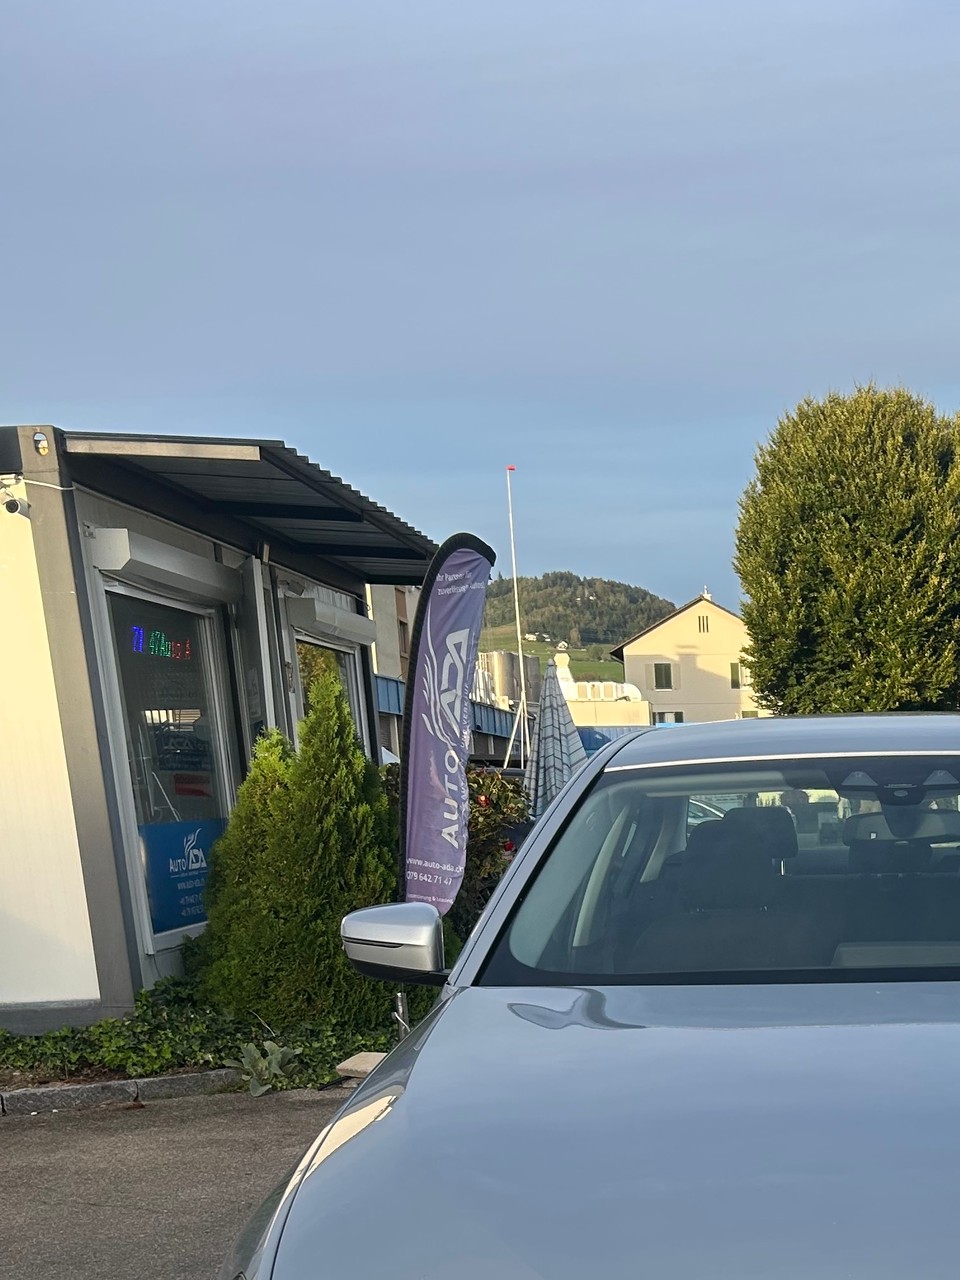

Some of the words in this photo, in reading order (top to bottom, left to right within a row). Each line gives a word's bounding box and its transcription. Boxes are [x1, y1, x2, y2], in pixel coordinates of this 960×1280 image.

[441, 750, 459, 849] AUTO
[418, 873, 432, 883] 642
[433, 875, 442, 884] 71
